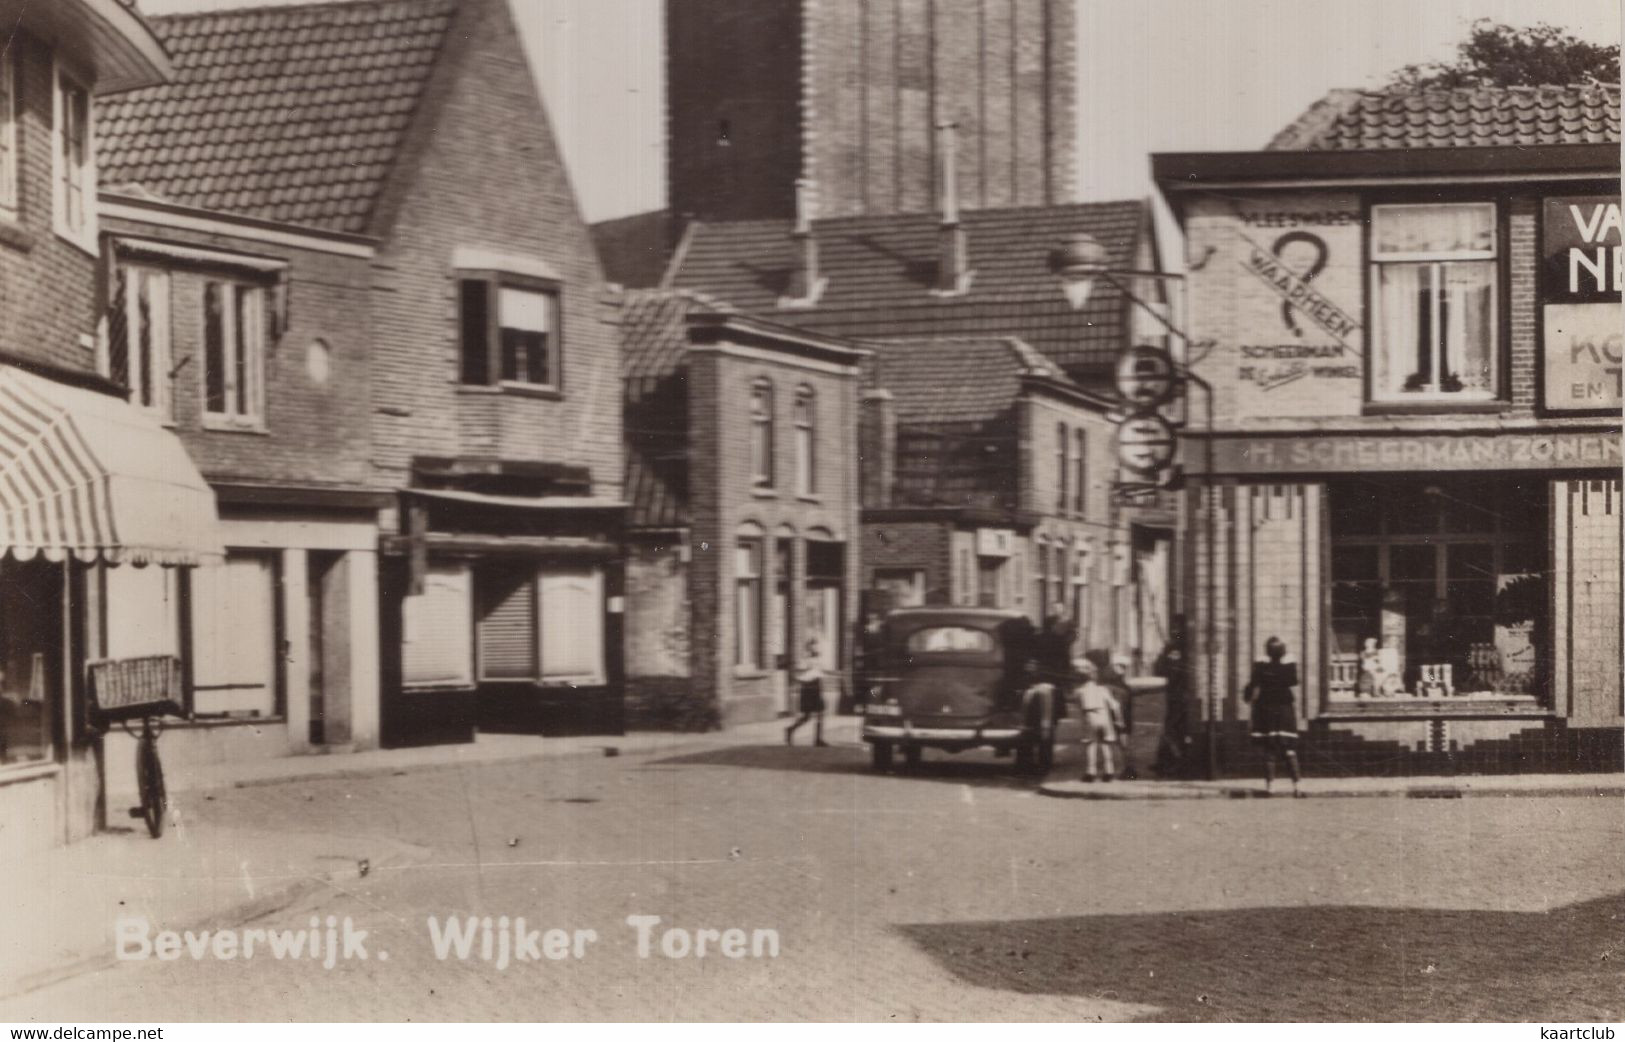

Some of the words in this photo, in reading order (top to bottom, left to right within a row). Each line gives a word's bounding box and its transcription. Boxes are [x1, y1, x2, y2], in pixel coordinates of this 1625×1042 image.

[1239, 345, 1344, 359] SCHEERMAN
[1571, 382, 1602, 399] EN
[1290, 438, 1495, 464] SCHEERMAN
[1511, 434, 1621, 461] ZONEN
